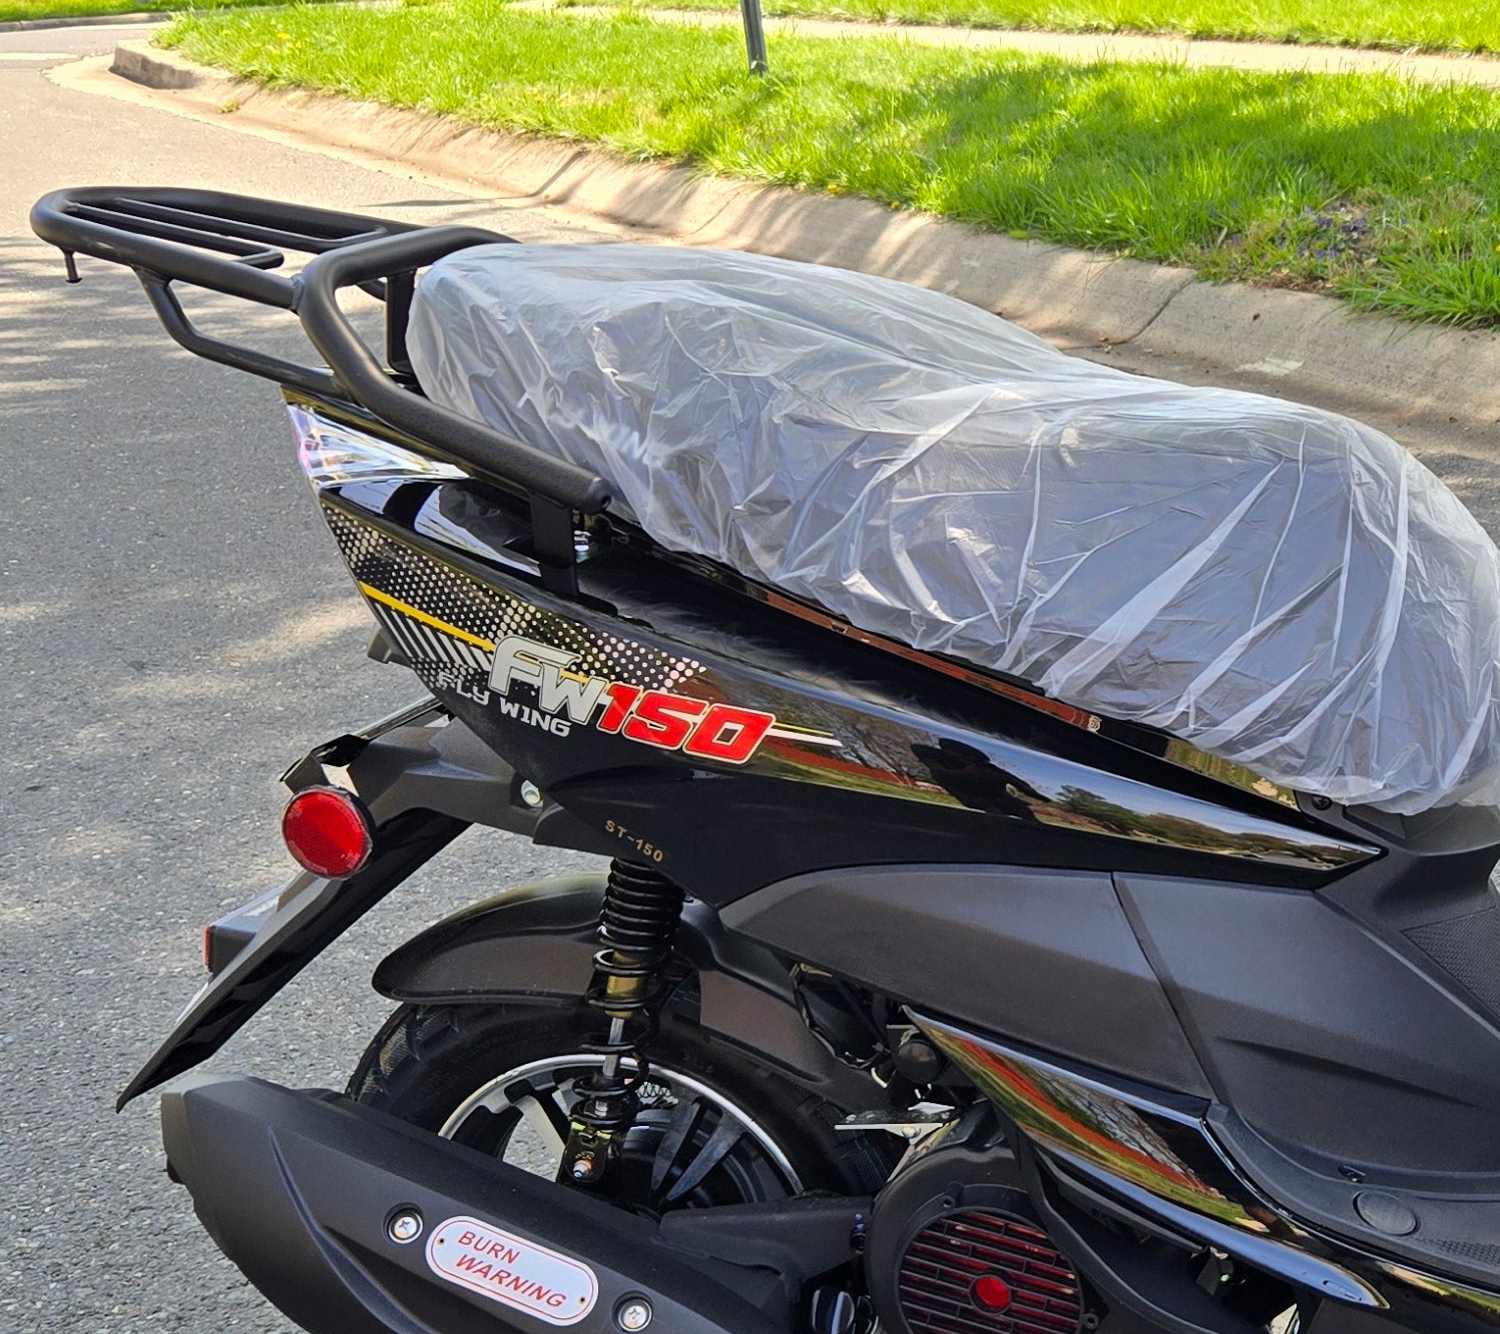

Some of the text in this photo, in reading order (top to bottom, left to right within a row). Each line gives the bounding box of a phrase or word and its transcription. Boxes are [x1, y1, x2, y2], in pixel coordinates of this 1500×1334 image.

[438, 671, 572, 737] FLY WING
[488, 635, 775, 765] FW150
[604, 819, 663, 862] ST-150
[457, 1231, 520, 1264] BURN
[457, 1254, 567, 1307] WARNING
